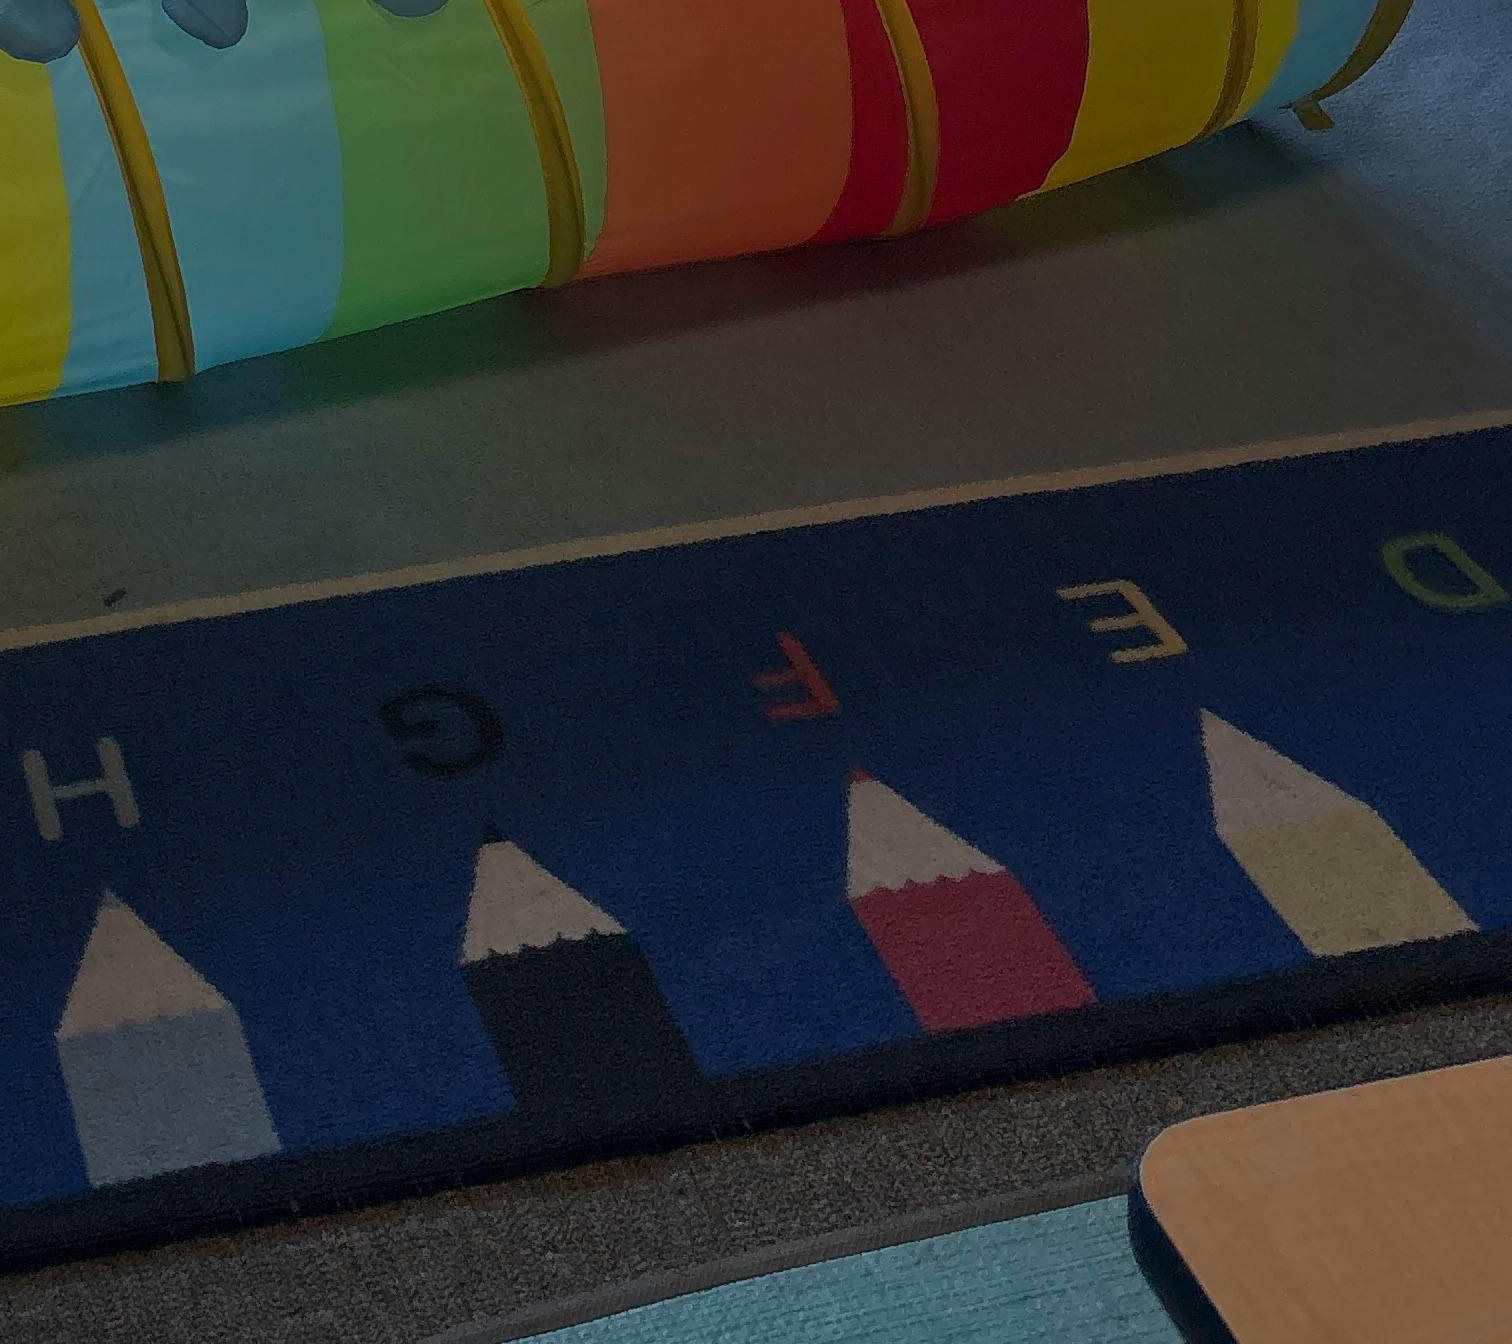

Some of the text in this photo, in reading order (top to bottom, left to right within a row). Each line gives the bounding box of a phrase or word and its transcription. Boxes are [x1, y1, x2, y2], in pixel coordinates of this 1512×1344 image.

[1381, 531, 1511, 612] D
[1055, 576, 1191, 666] E
[750, 629, 843, 726] F
[378, 684, 506, 780] G
[21, 736, 143, 843] H
